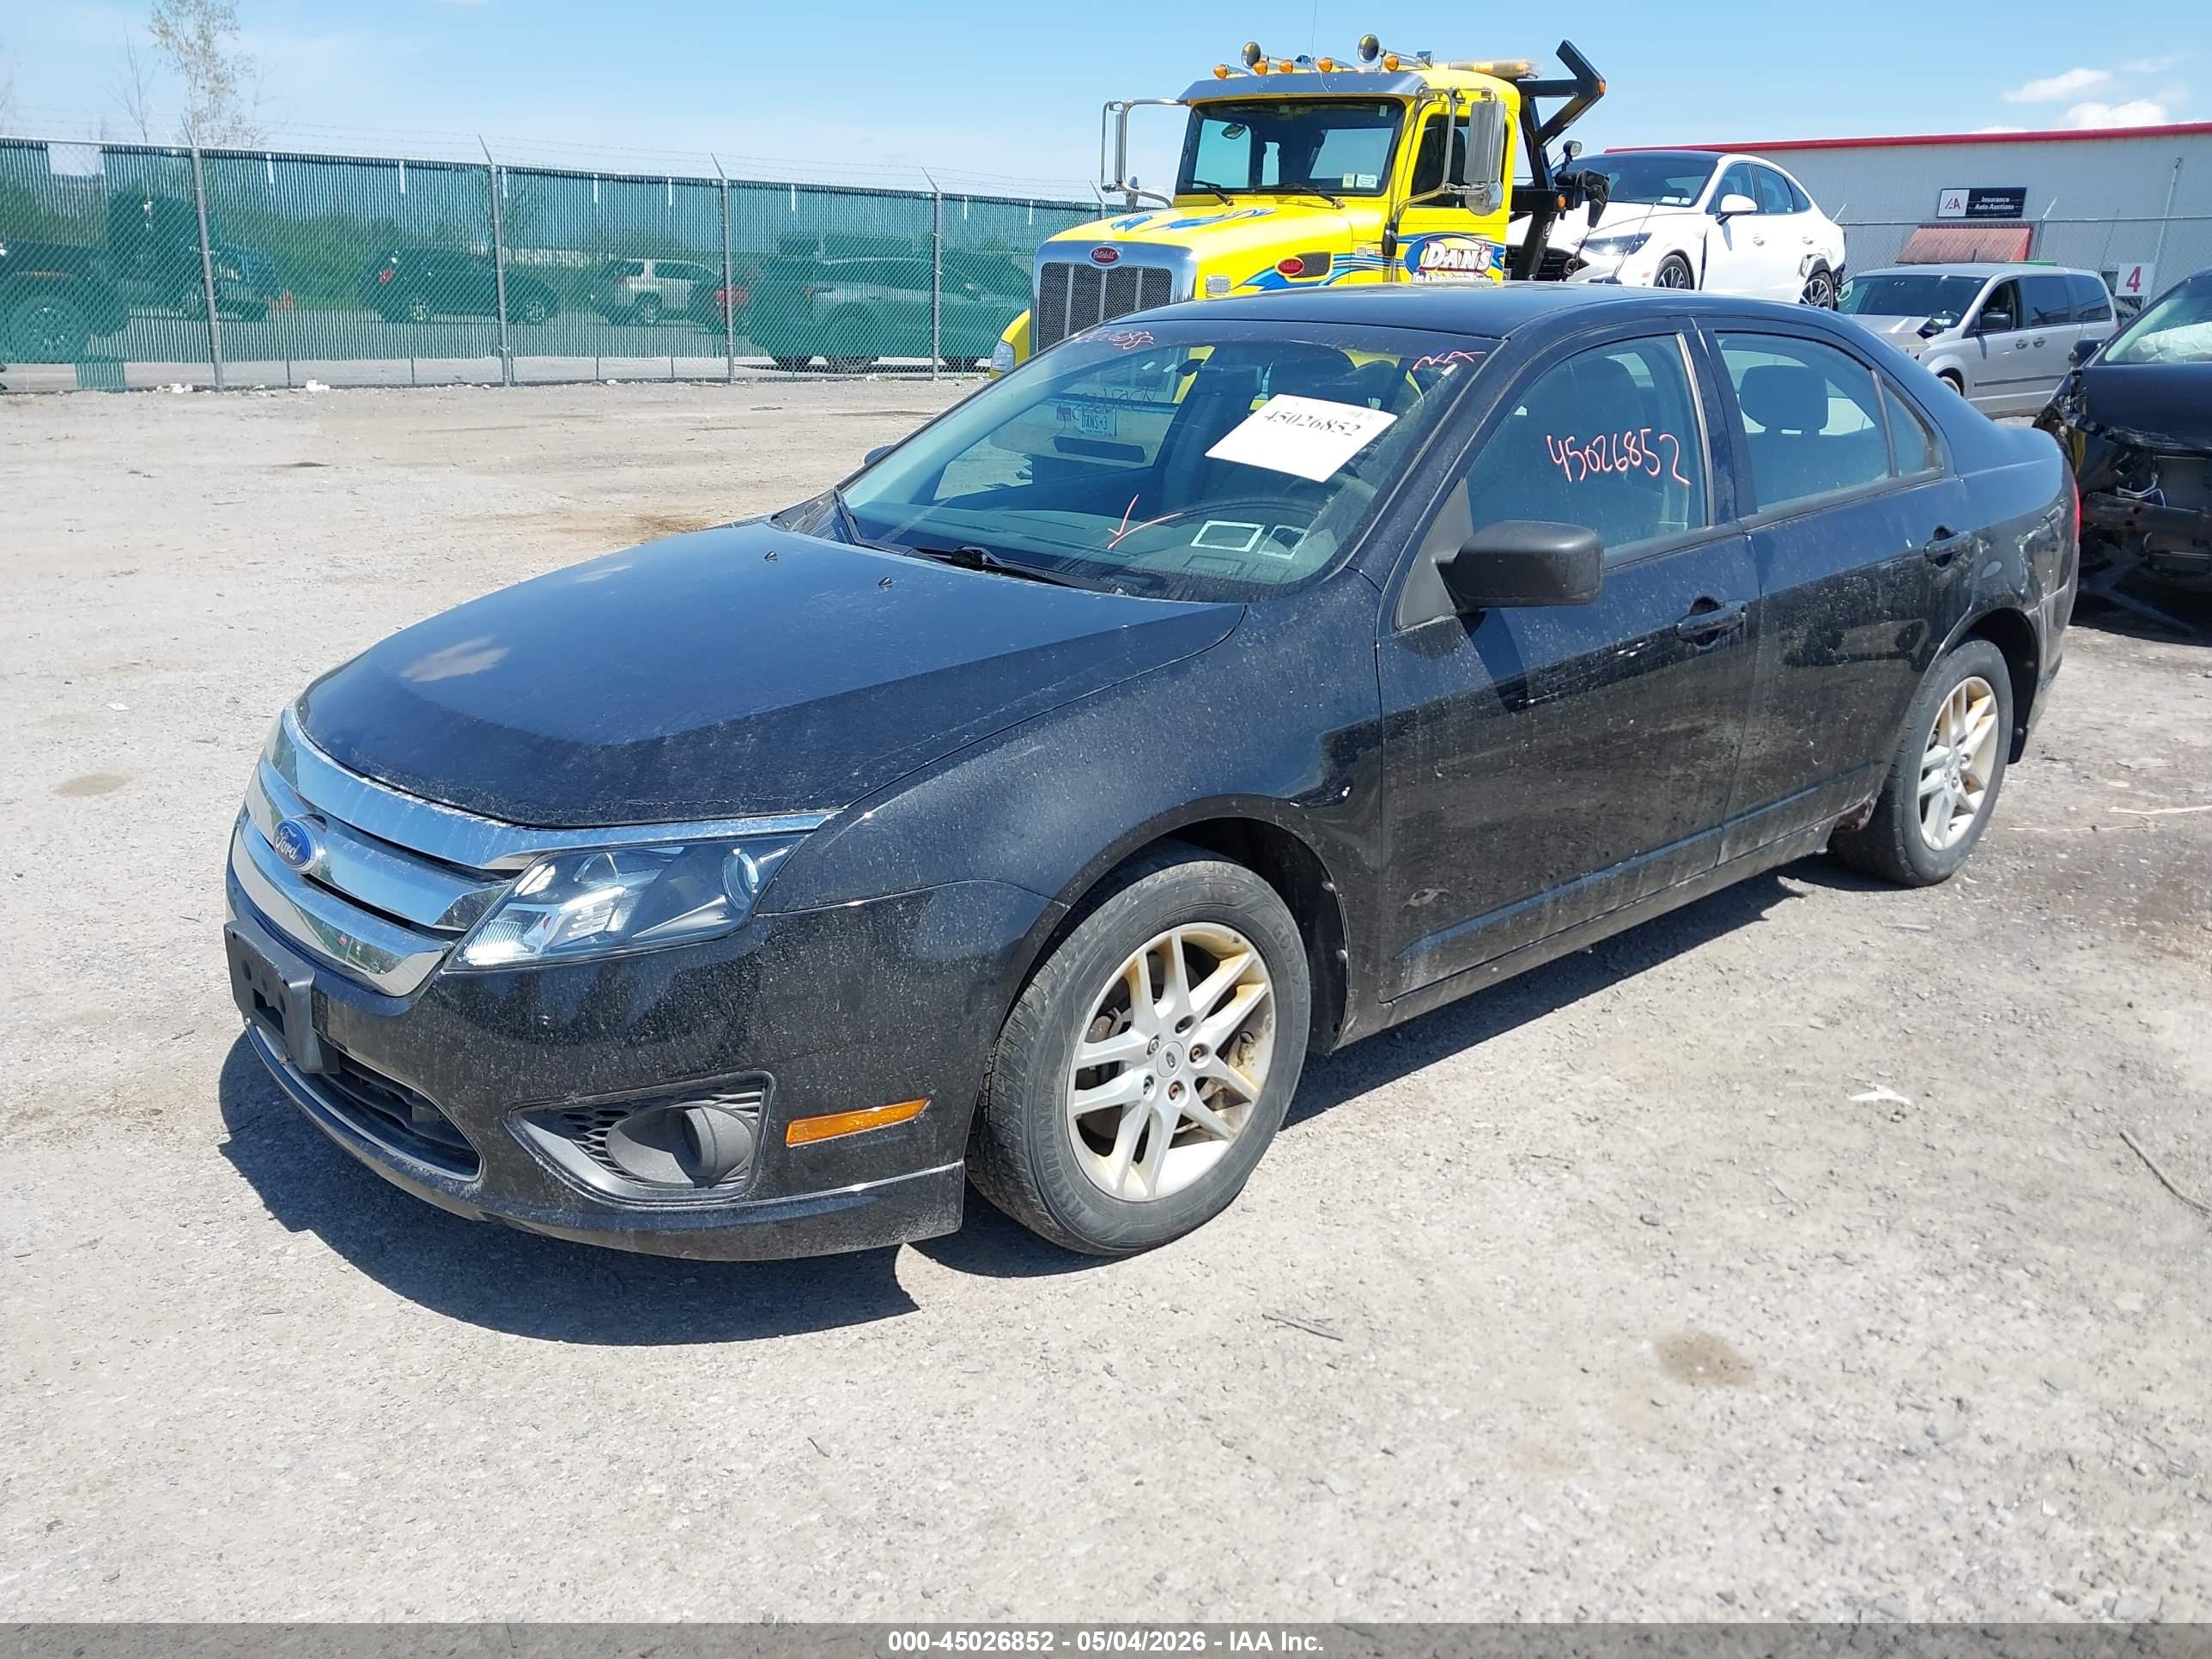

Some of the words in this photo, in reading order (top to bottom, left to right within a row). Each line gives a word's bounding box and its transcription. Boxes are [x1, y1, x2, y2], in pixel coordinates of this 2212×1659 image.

[2125, 265, 2142, 293] 4
[1264, 410, 1362, 436] 45026852
[1546, 428, 1692, 486] 45026852
[275, 825, 301, 860] Ford
